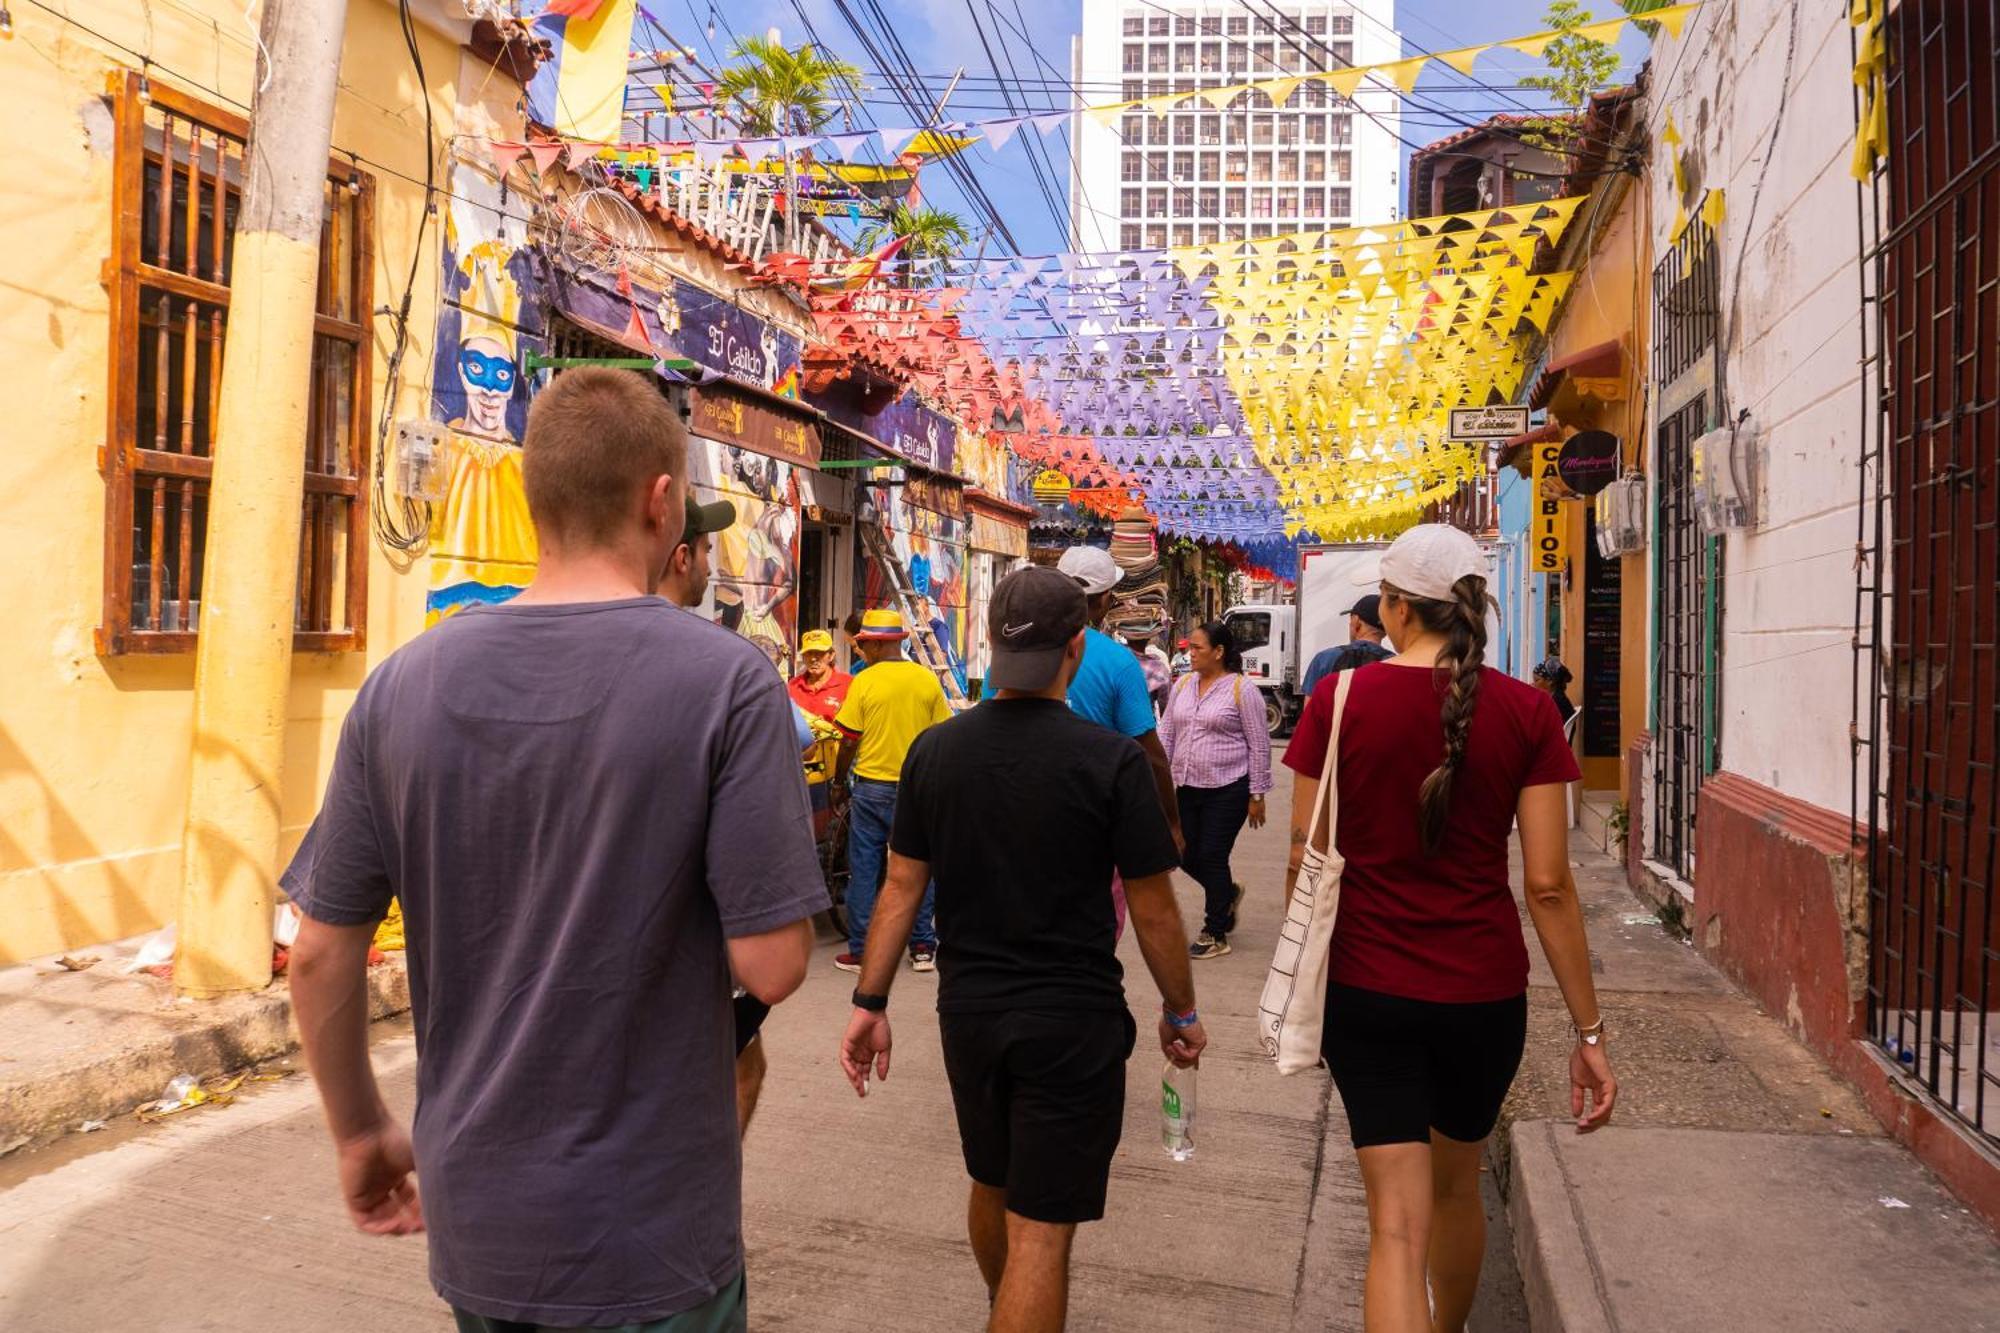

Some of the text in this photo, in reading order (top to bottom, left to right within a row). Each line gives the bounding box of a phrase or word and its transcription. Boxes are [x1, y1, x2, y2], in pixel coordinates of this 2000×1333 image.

[708, 325, 761, 374] El Cabildo
[1541, 447, 1560, 568] CABIOS
